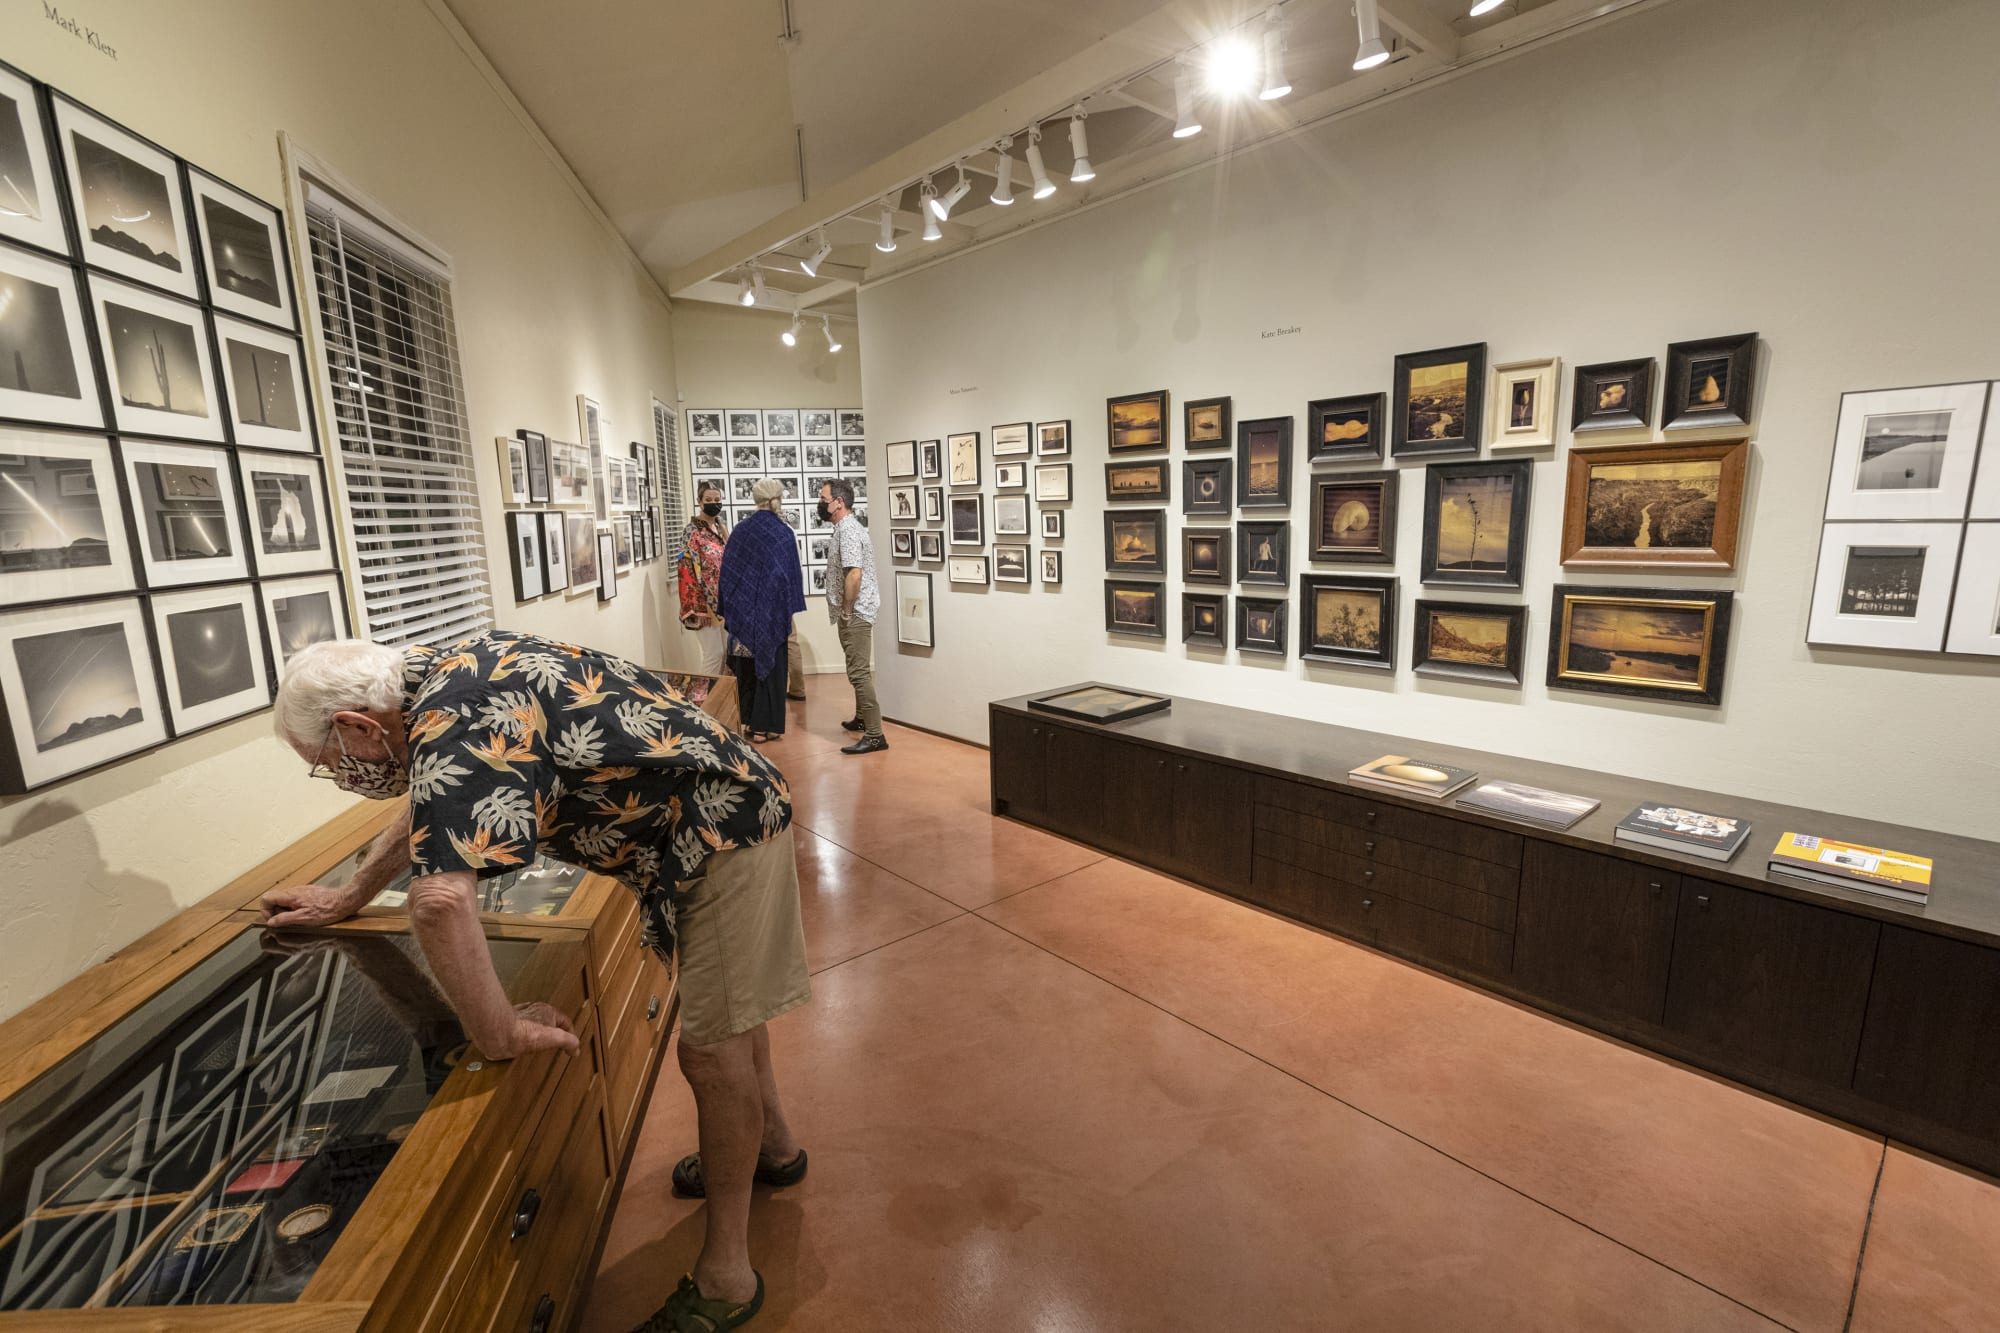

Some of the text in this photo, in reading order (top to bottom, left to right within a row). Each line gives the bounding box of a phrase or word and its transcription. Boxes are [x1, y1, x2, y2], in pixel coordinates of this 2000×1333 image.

[42, 0, 118, 61] Mark Klett
[1261, 330, 1276, 339] Kate
